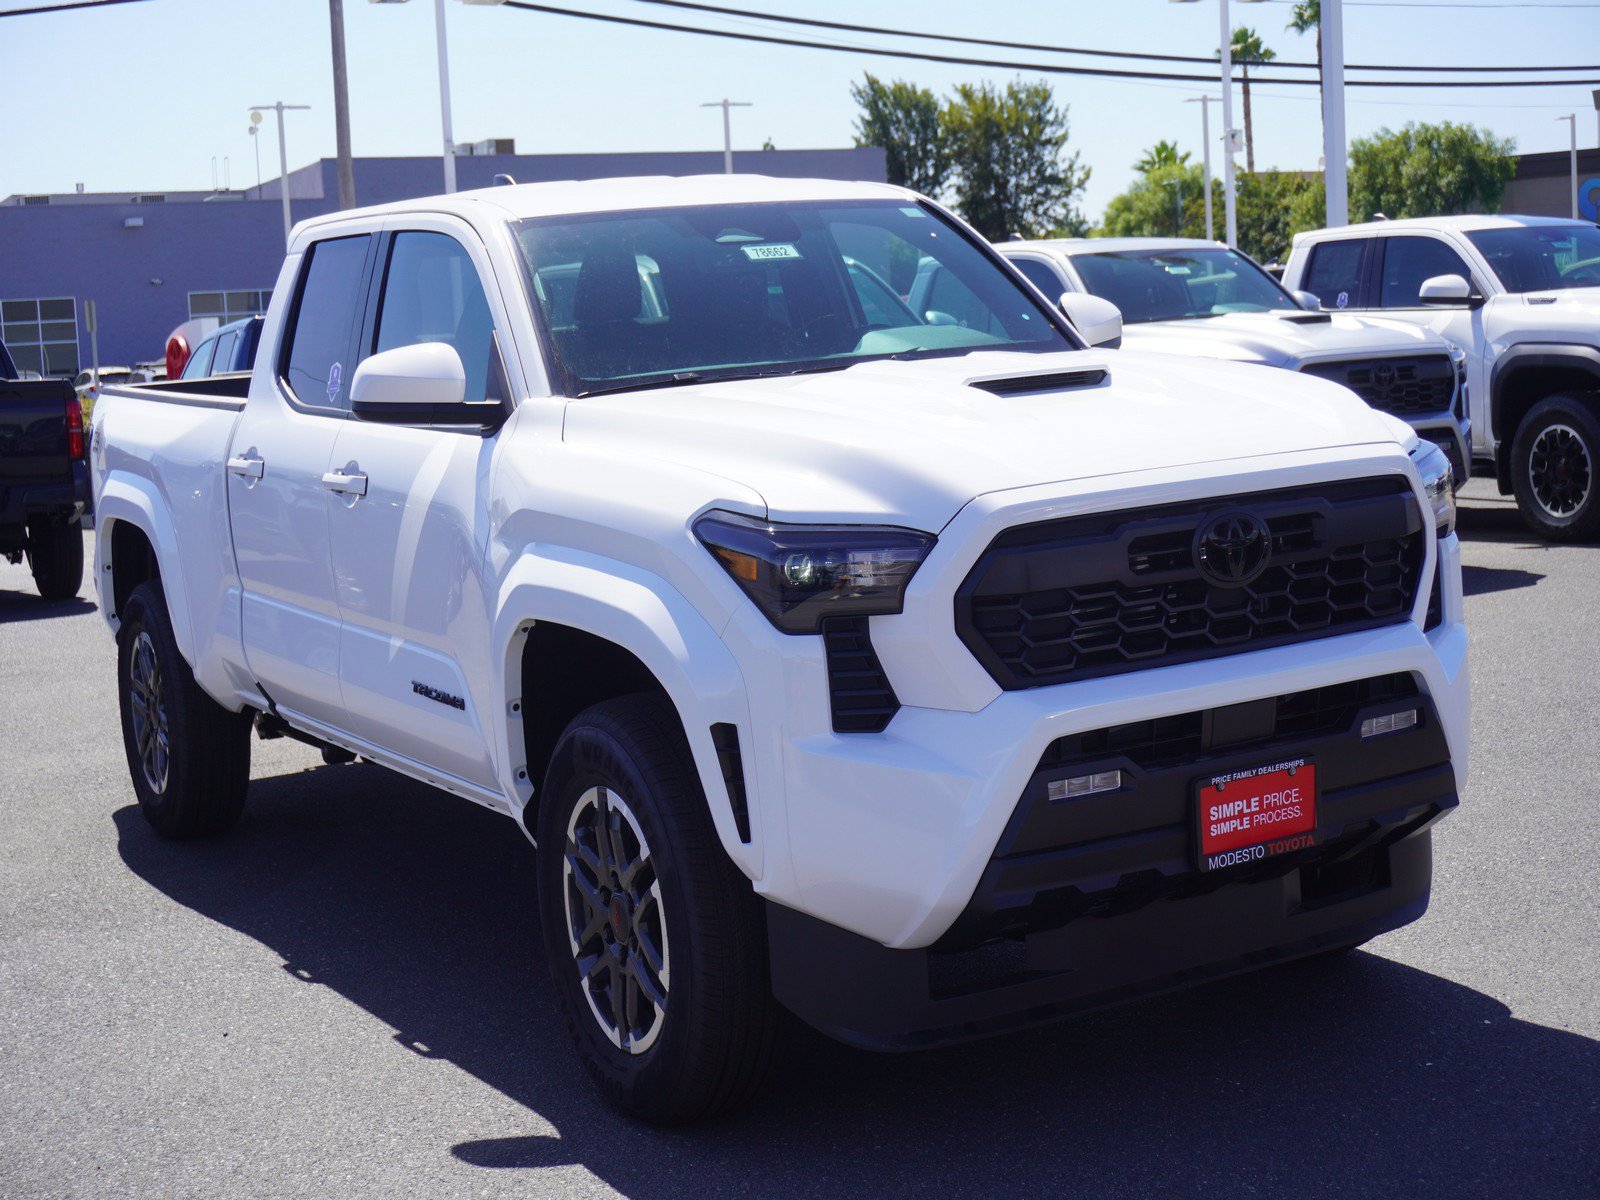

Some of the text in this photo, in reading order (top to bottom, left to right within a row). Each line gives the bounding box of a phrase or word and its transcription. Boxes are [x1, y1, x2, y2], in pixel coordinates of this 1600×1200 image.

[751, 246, 791, 258] 78662
[411, 679, 466, 711] TACOMA
[1211, 758, 1305, 786] PRICE FAMILY DEALERSHIPS
[1209, 788, 1303, 821] SIMPLE PRICE.
[1210, 805, 1304, 837] SIMPLE PROCESS.
[1208, 834, 1316, 871] MODESTO TOYOTA
